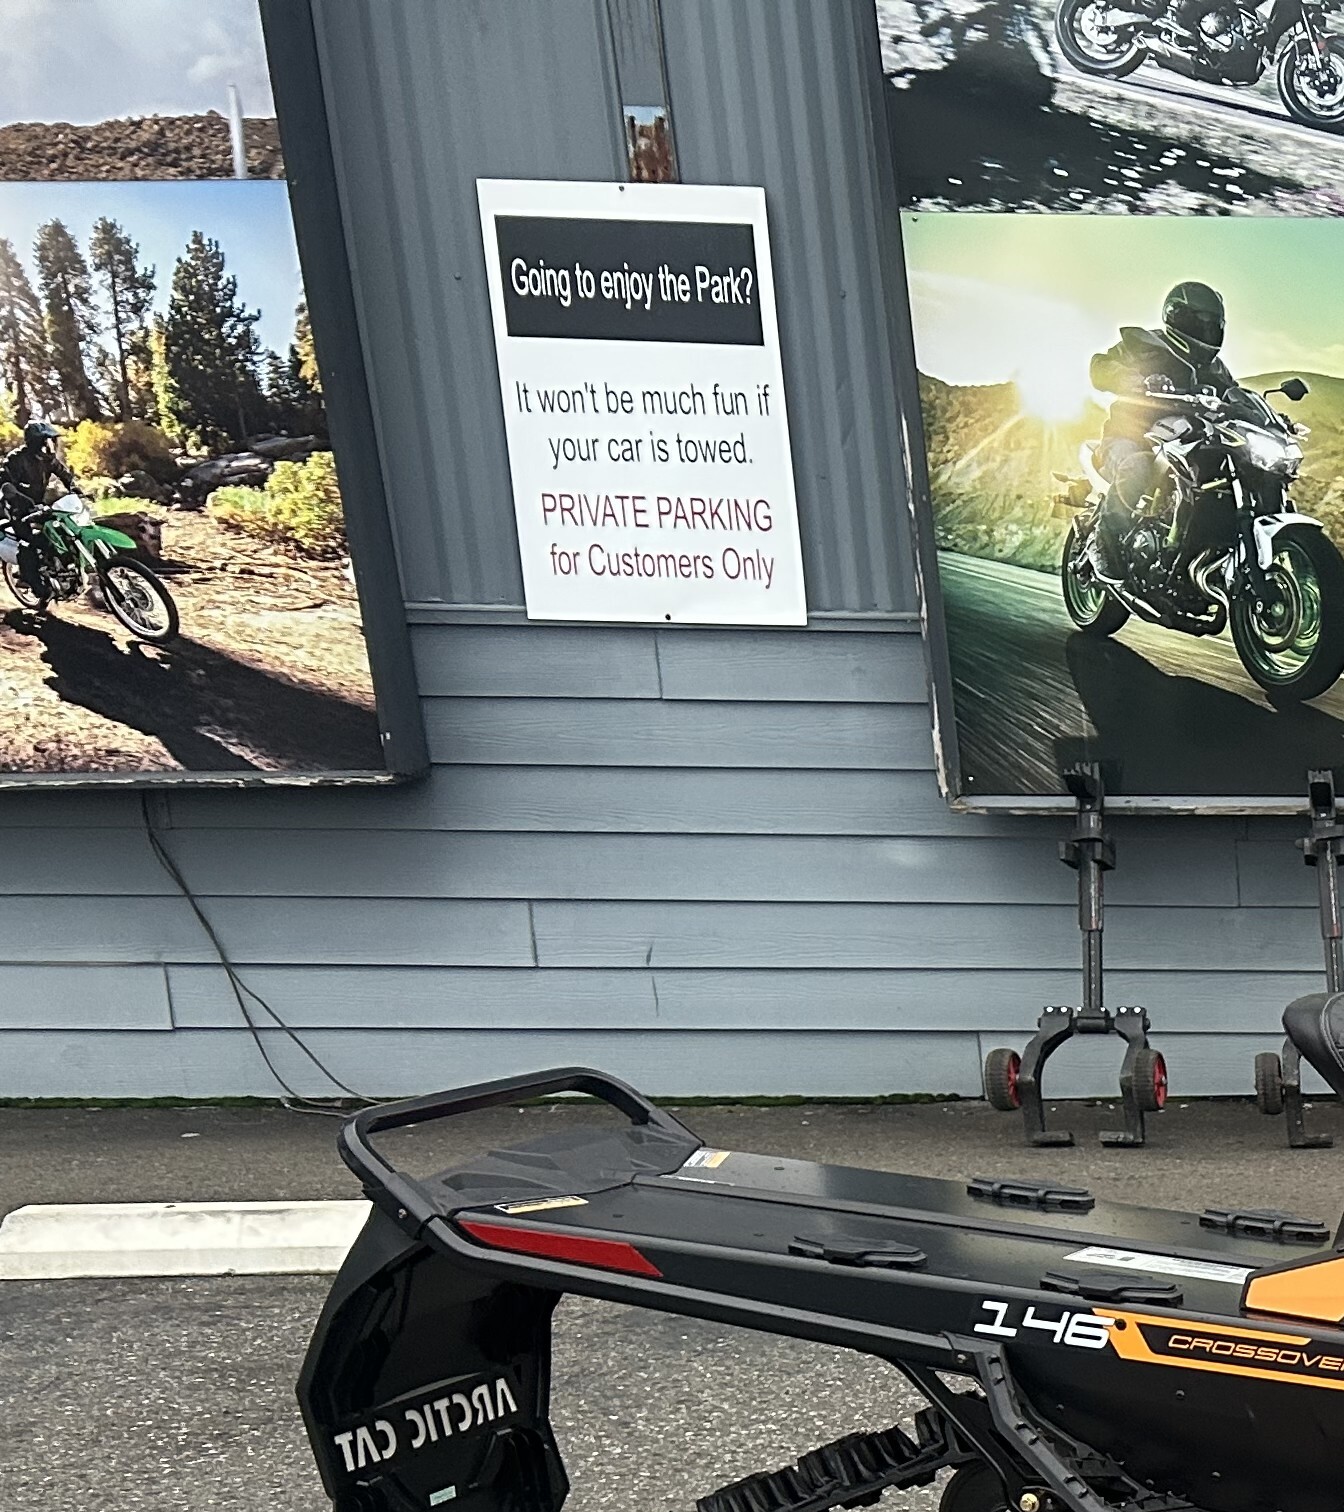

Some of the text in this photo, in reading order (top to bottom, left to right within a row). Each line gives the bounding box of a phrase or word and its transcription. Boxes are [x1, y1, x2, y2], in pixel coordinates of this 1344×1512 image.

[511, 257, 753, 310] Going to enjoy the Park?
[515, 381, 770, 416] It won't be much fun if
[549, 431, 754, 469] your car is towed.
[541, 493, 773, 532] PRIVATE PARKING
[550, 543, 775, 589] for Customers Only
[973, 1300, 1116, 1350] 146
